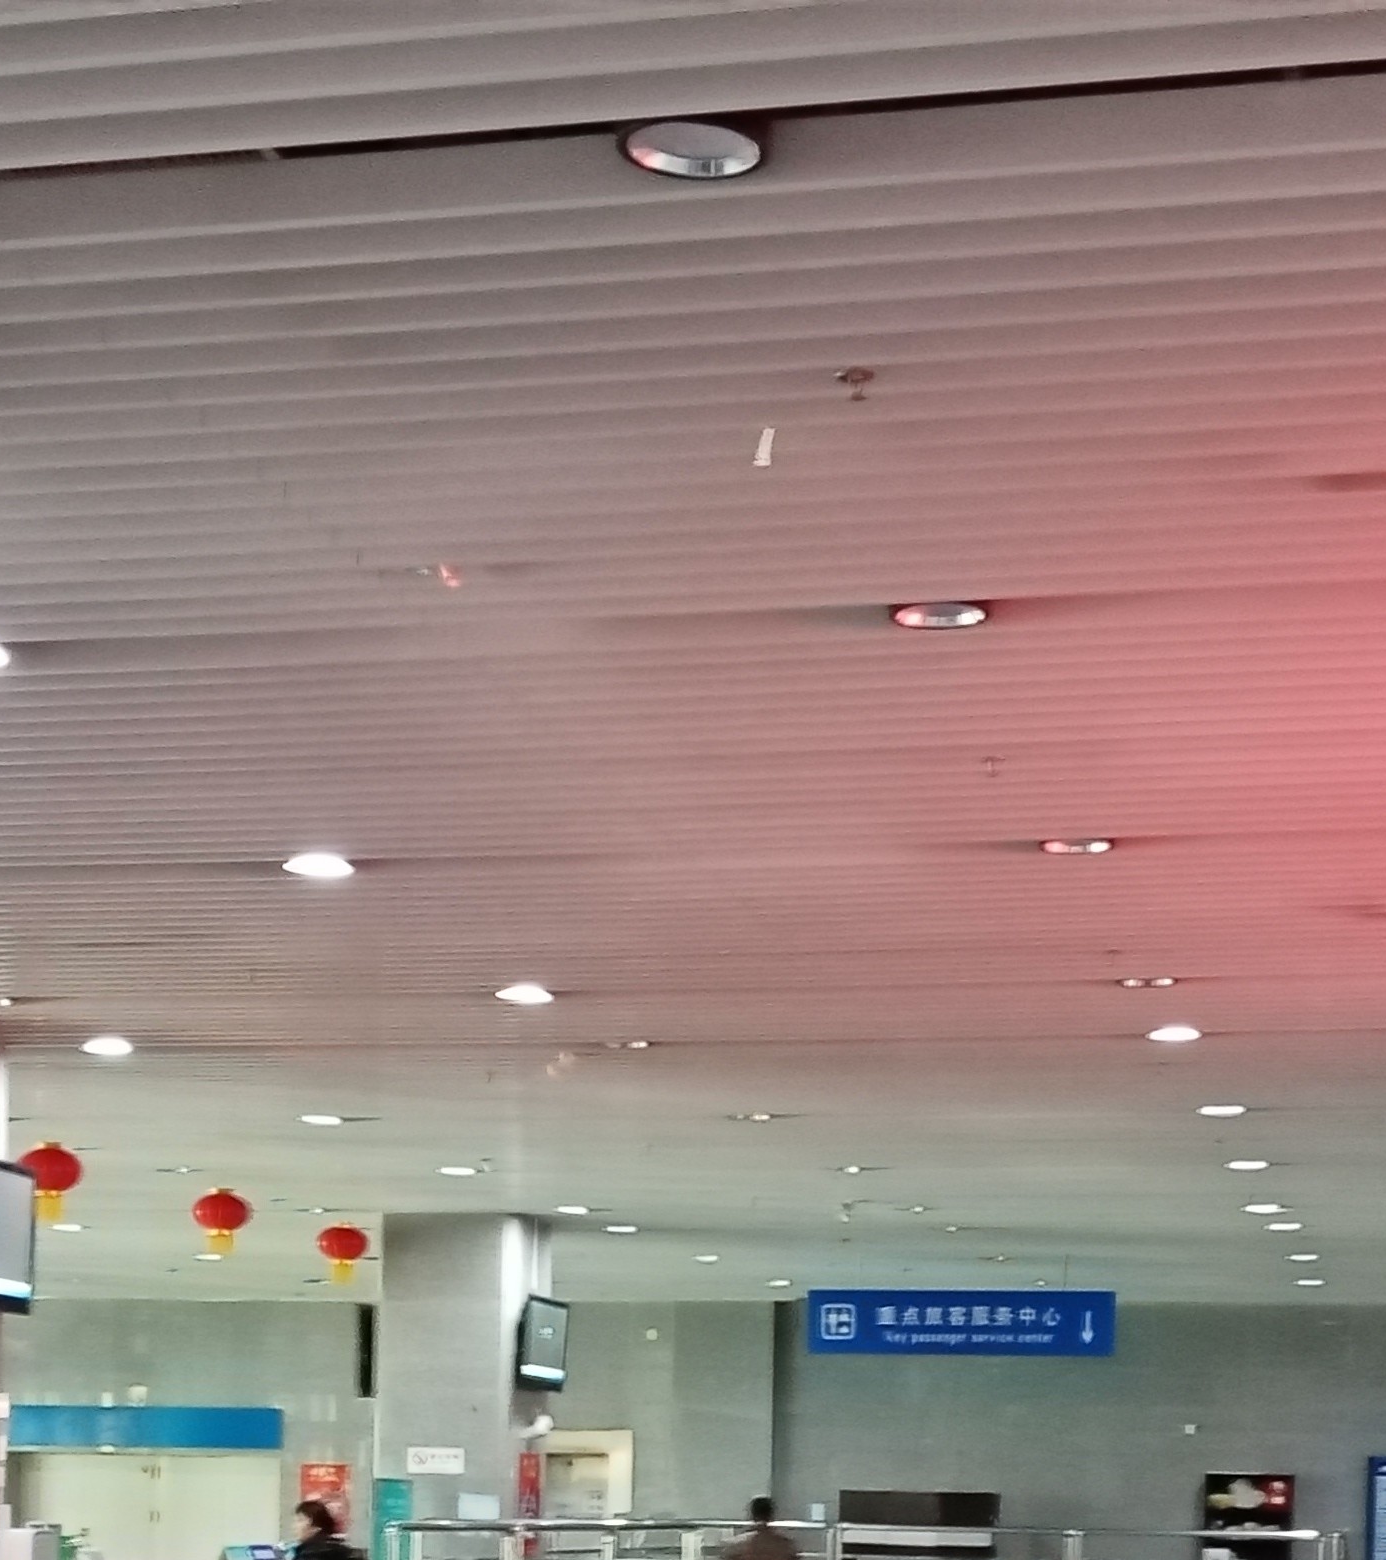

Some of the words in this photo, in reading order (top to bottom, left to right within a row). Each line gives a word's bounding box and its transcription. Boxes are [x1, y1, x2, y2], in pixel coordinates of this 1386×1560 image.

[875, 1305, 1061, 1327] 重点旅客服务中心
[1016, 1333, 1055, 1343] center
